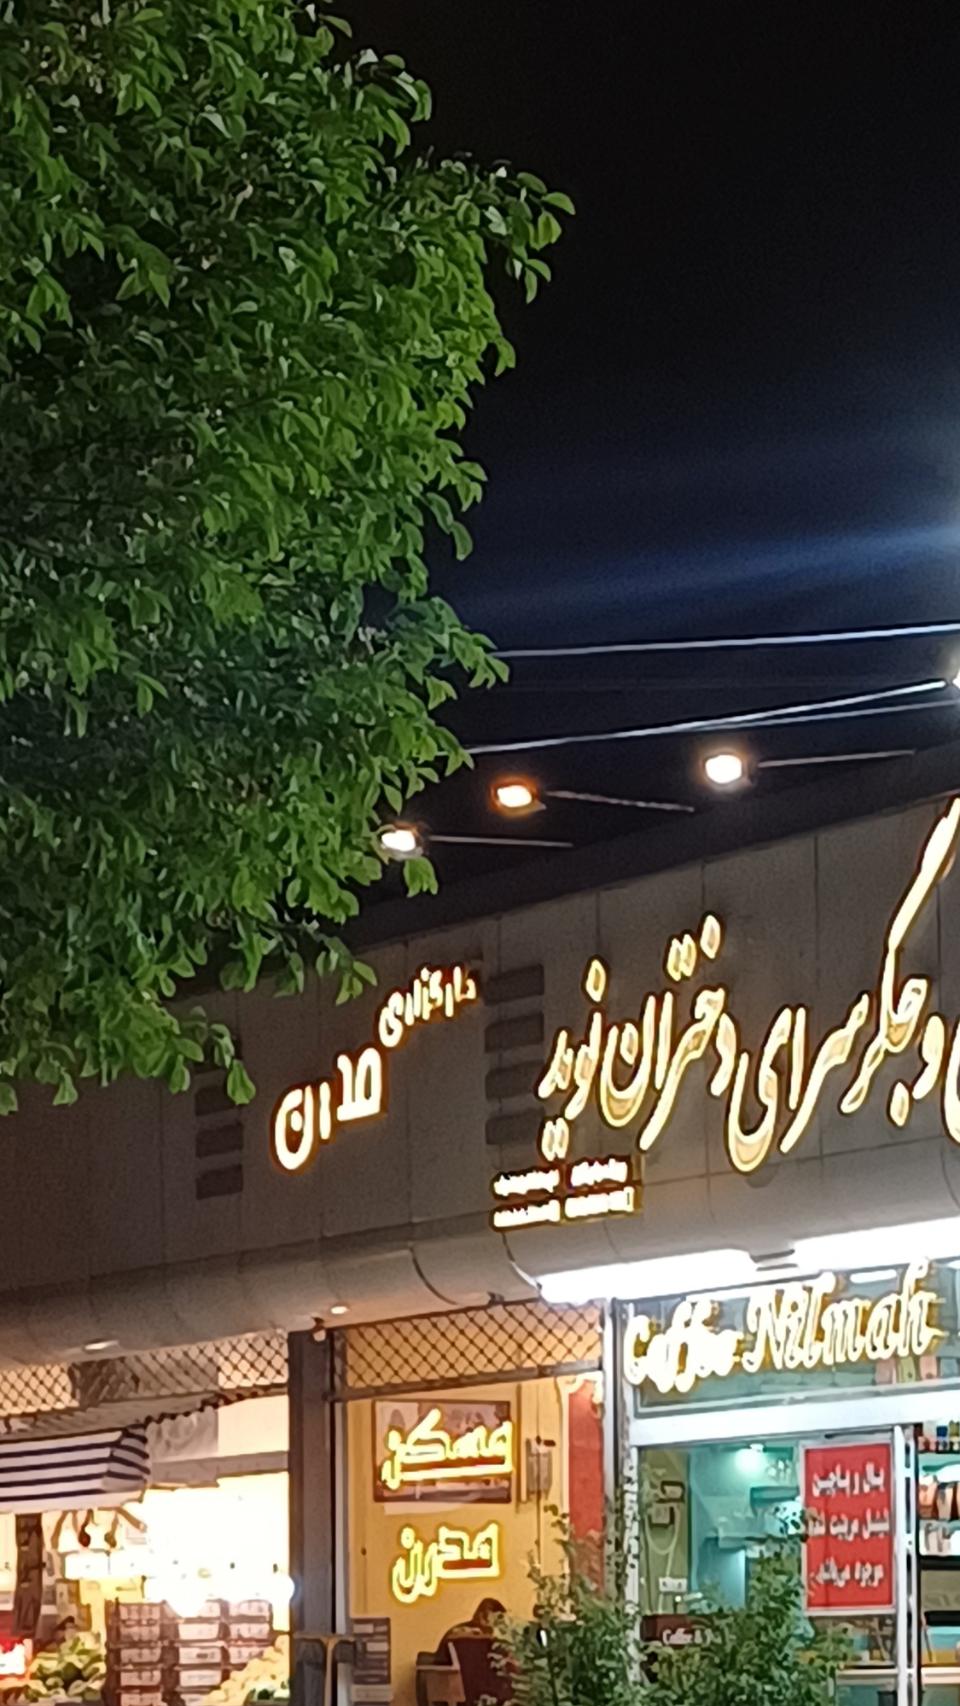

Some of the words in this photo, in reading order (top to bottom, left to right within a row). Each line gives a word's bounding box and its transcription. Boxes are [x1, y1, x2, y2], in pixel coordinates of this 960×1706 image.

[911, 1014, 945, 1100] و
[381, 1407, 513, 1490] مسکن
[391, 1522, 500, 1604] مدرن
